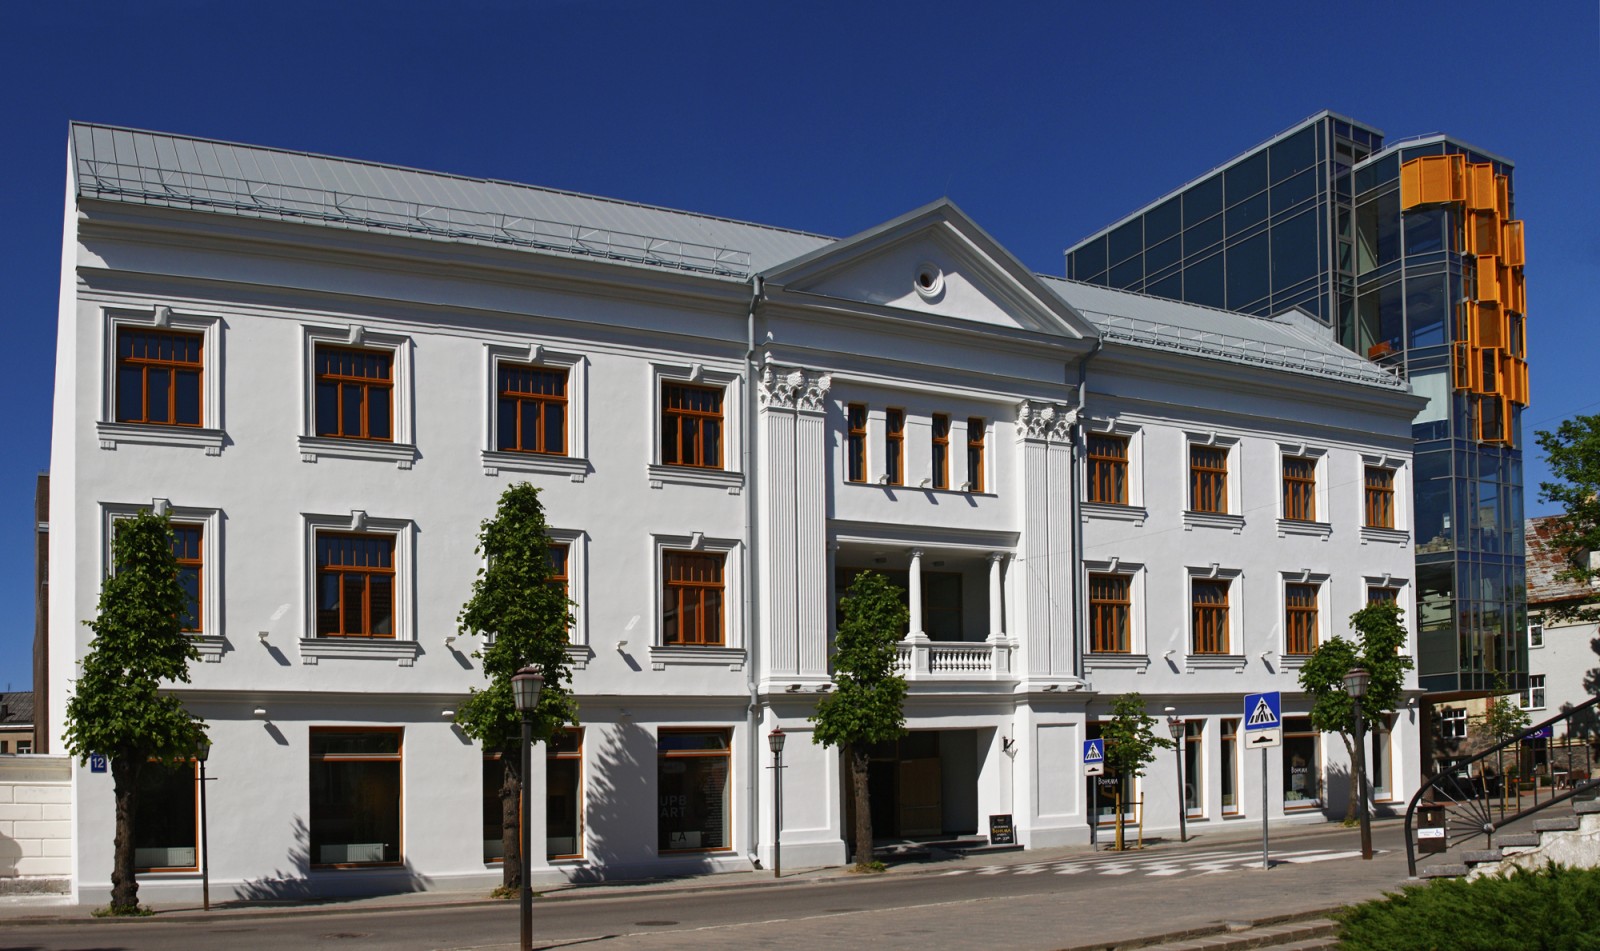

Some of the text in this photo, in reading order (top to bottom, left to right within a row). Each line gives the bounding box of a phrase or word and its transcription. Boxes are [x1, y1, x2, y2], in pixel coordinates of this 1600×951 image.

[92, 757, 104, 768] 12
[660, 795, 687, 806] UPB
[660, 807, 687, 818] ART
